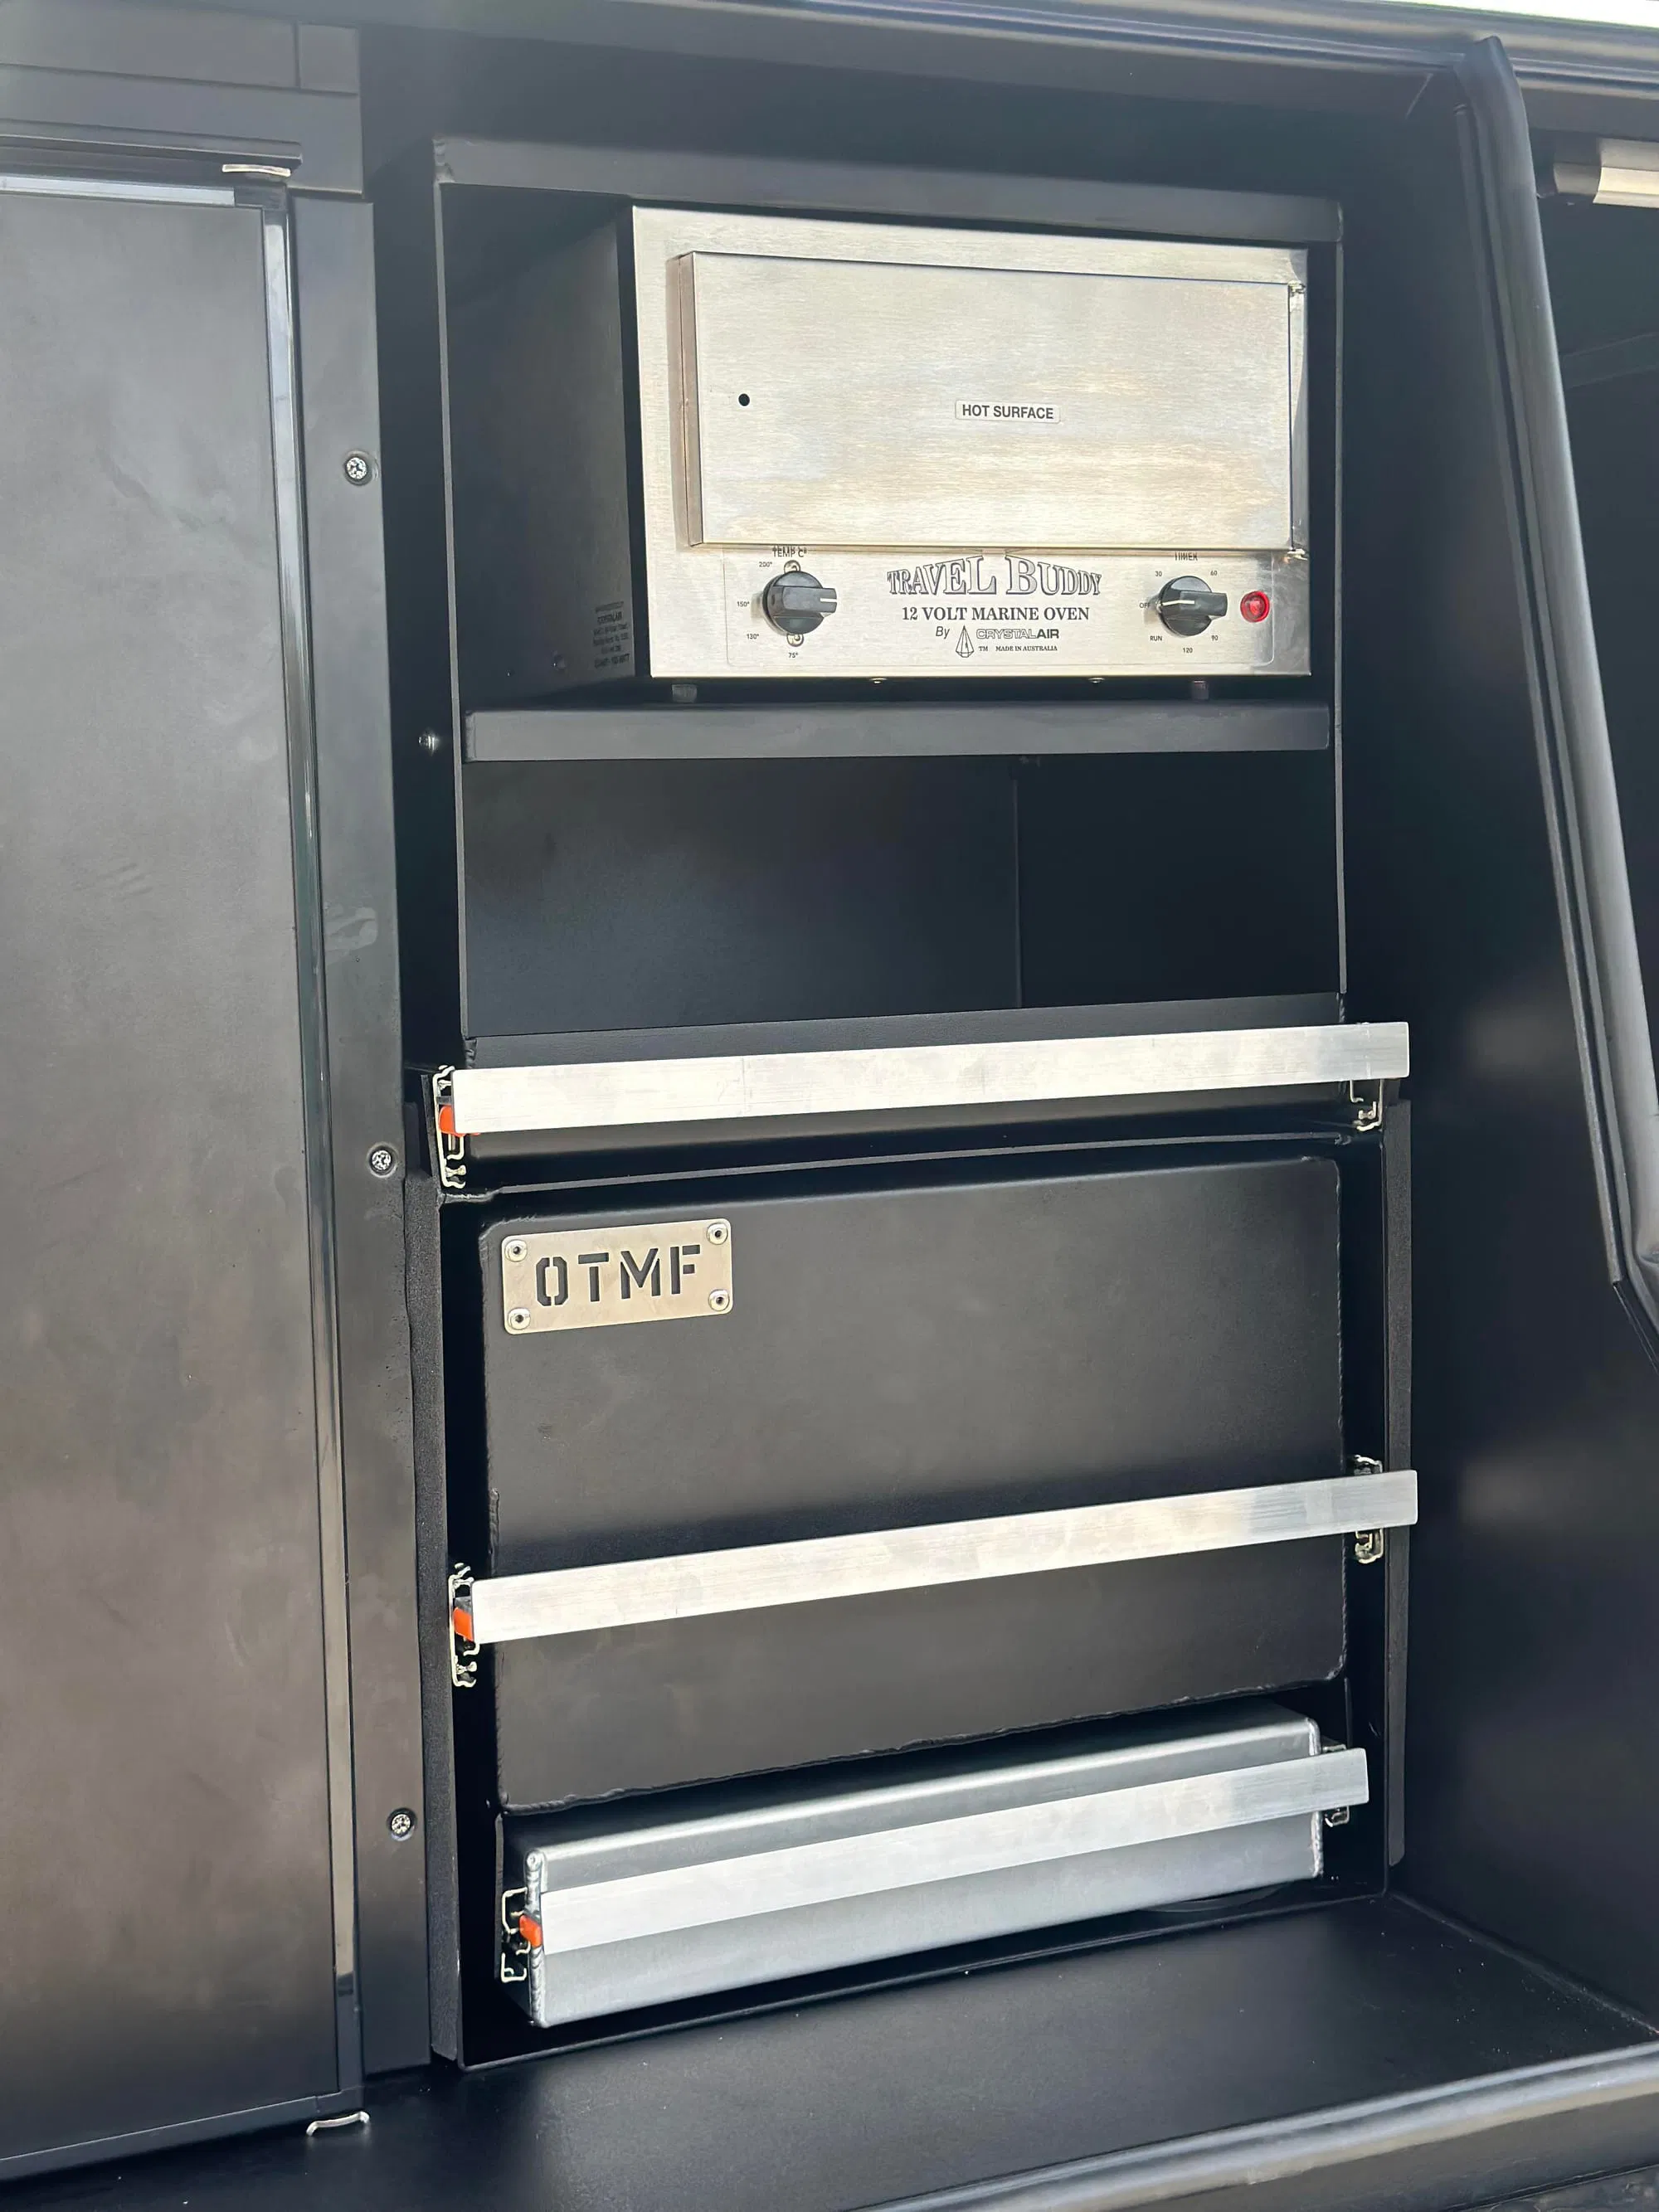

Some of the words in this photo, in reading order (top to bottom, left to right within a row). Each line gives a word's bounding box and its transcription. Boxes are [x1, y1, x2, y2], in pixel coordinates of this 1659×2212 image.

[962, 404, 990, 416] HOT
[993, 405, 1053, 419] SURFACE
[772, 548, 795, 557] TEMP
[887, 555, 996, 596] TRAVEL
[1005, 554, 1102, 596] BUDDY
[902, 606, 918, 620] 12
[922, 606, 967, 620] VOLT
[971, 607, 1039, 620] MARINE
[1044, 607, 1089, 620] OVEN
[935, 625, 950, 639] By
[975, 628, 1059, 639] CRYSTALAIR
[535, 1244, 701, 1307] OTMF
